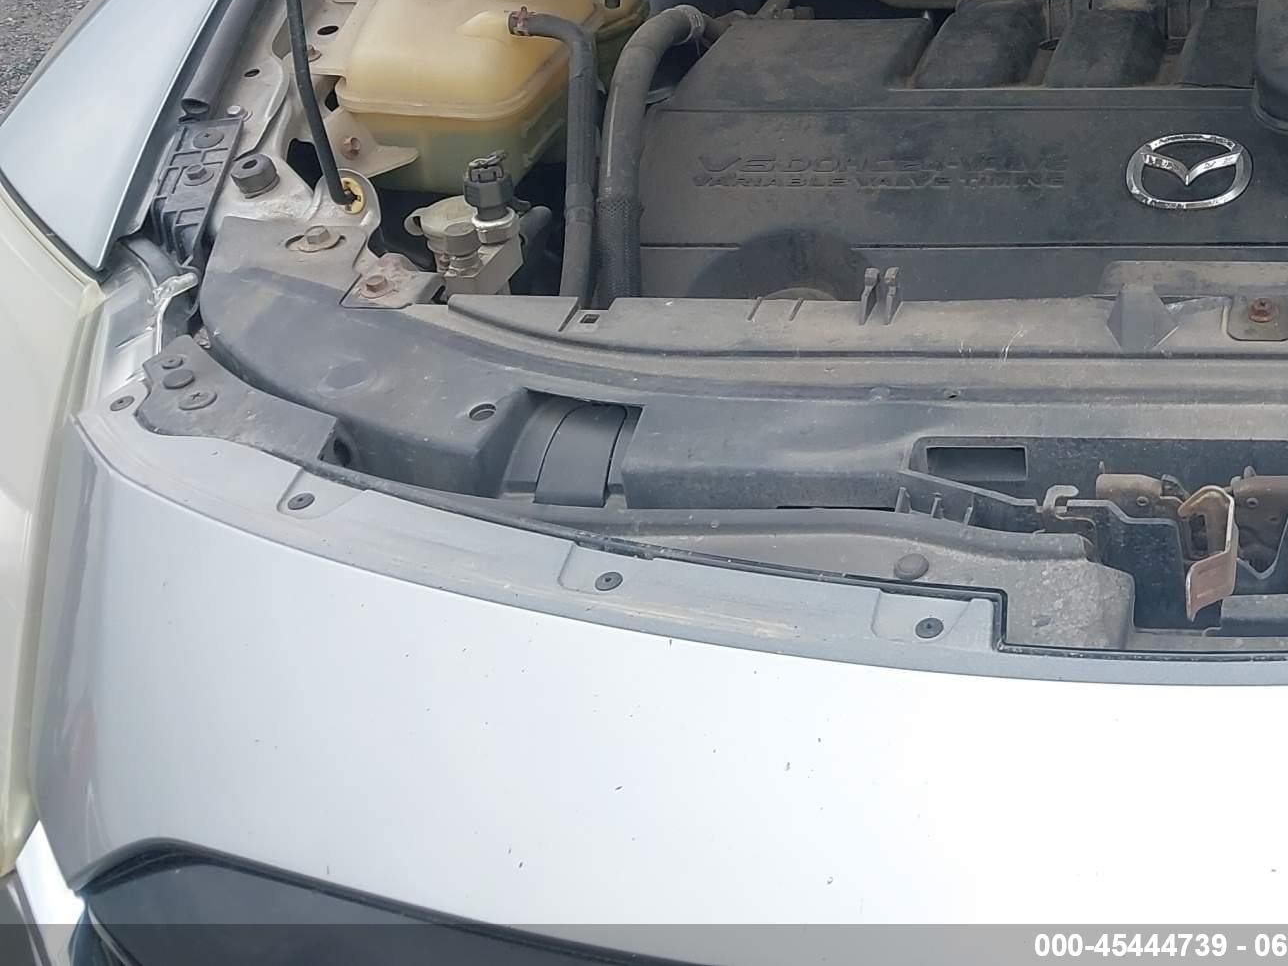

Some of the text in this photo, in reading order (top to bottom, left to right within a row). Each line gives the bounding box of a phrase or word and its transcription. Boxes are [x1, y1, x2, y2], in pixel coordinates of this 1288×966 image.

[698, 153, 776, 173] V6
[779, 153, 894, 173] DOHC
[692, 174, 1065, 188] VARIABLE VALVE TIMING
